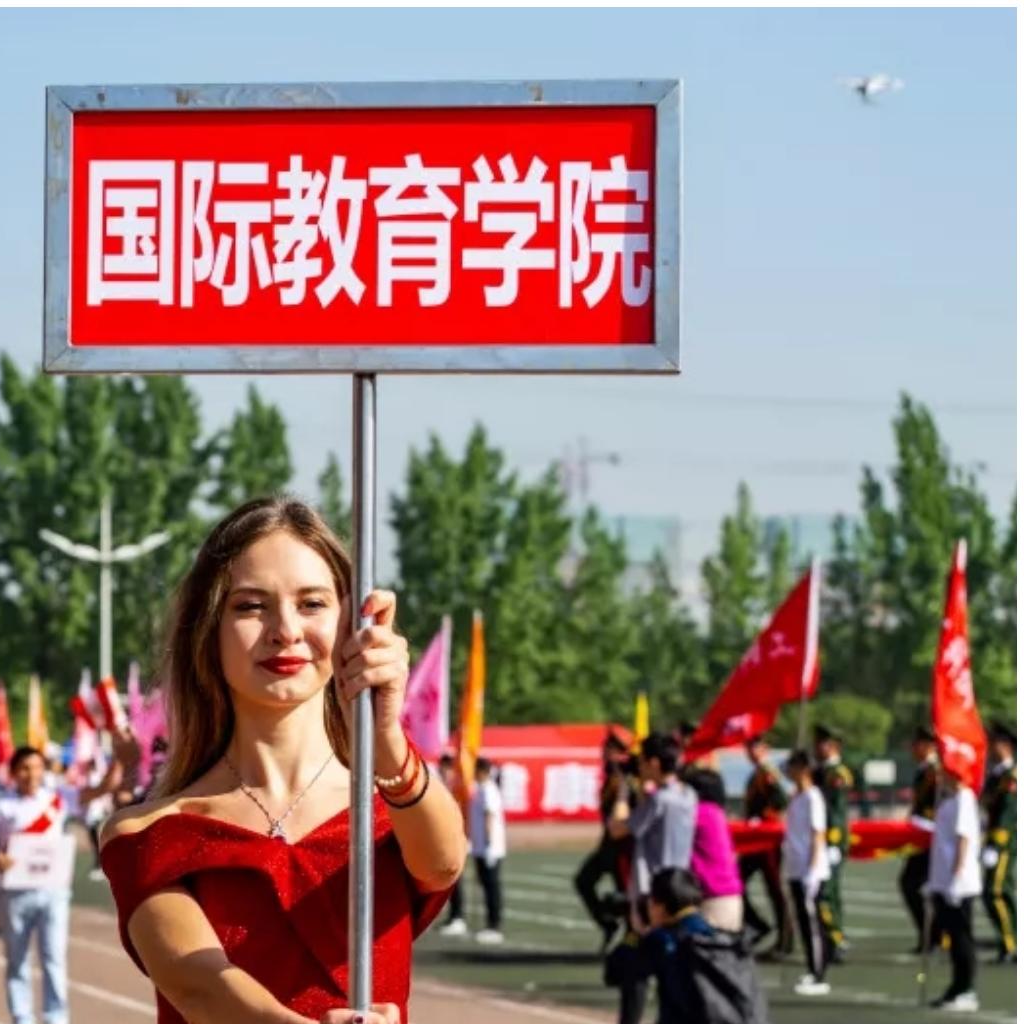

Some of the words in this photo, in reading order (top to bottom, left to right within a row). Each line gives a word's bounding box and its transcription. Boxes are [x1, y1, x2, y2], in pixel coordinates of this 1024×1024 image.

[86, 154, 652, 308] 国际教育学院
